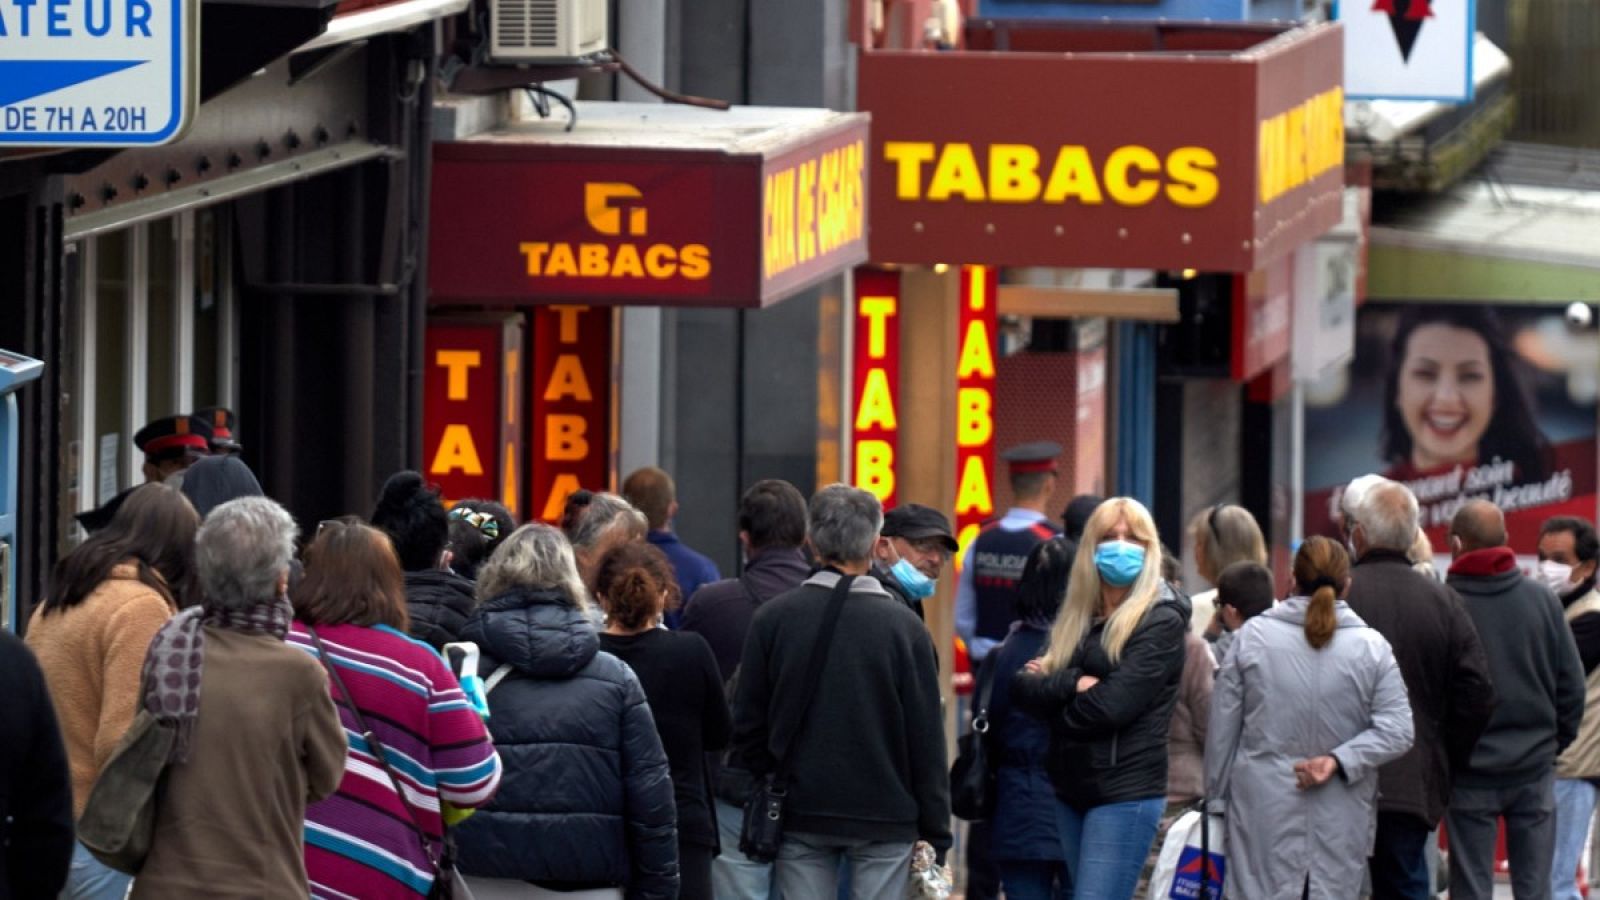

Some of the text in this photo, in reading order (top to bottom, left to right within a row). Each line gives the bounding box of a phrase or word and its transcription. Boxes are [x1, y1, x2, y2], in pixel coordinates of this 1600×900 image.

[5, 106, 146, 131] DE 7H A 20H
[884, 142, 1220, 207] TABACS
[520, 242, 711, 279] TABACS
[855, 297, 897, 501] TAB
[430, 350, 484, 507] TA
[1465, 456, 1514, 491] soin
